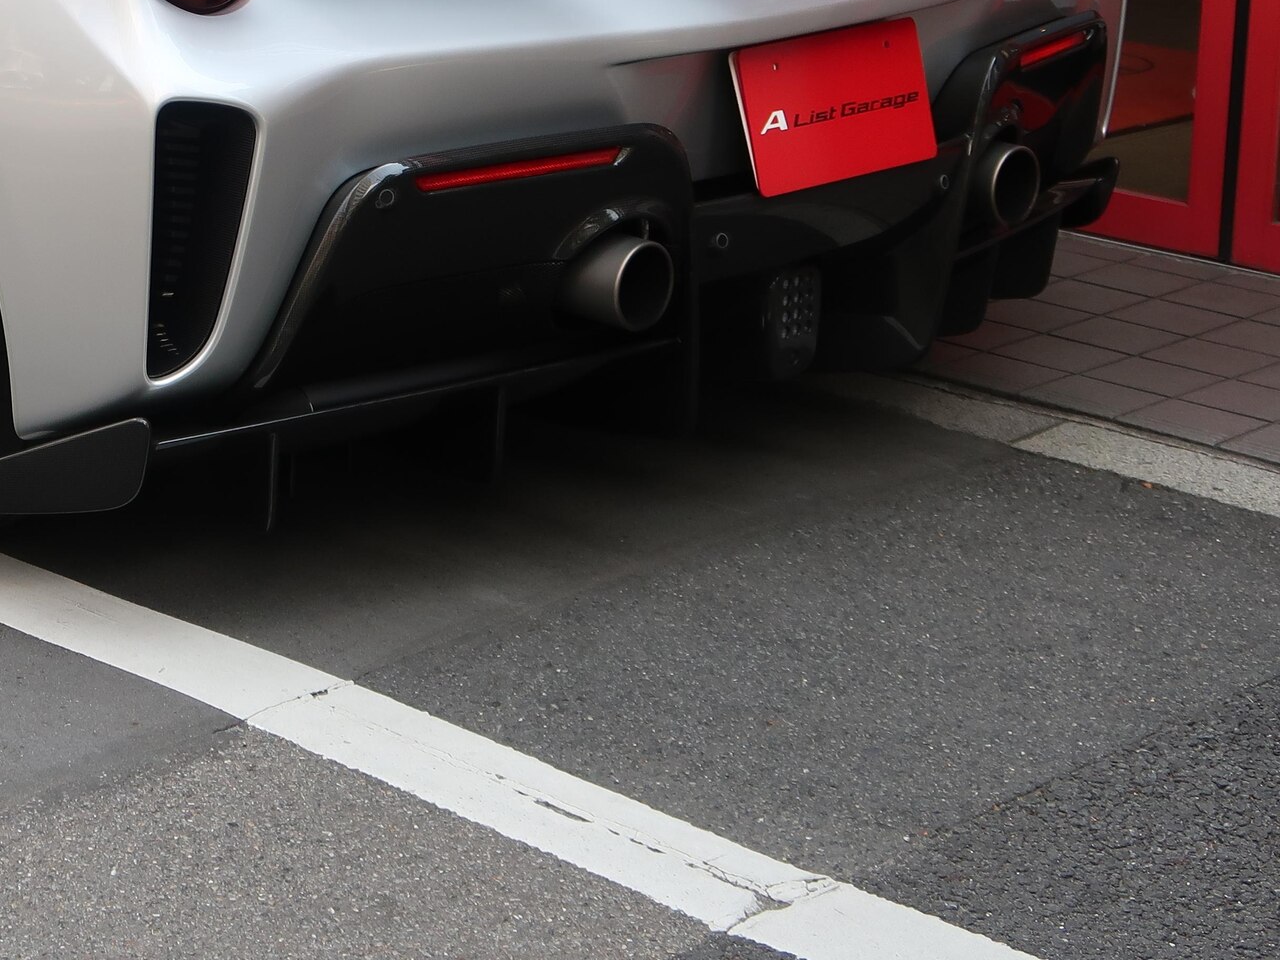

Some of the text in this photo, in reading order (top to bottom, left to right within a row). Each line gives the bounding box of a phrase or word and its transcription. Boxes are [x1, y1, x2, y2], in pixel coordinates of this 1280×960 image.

[759, 91, 920, 136] A List Garage
